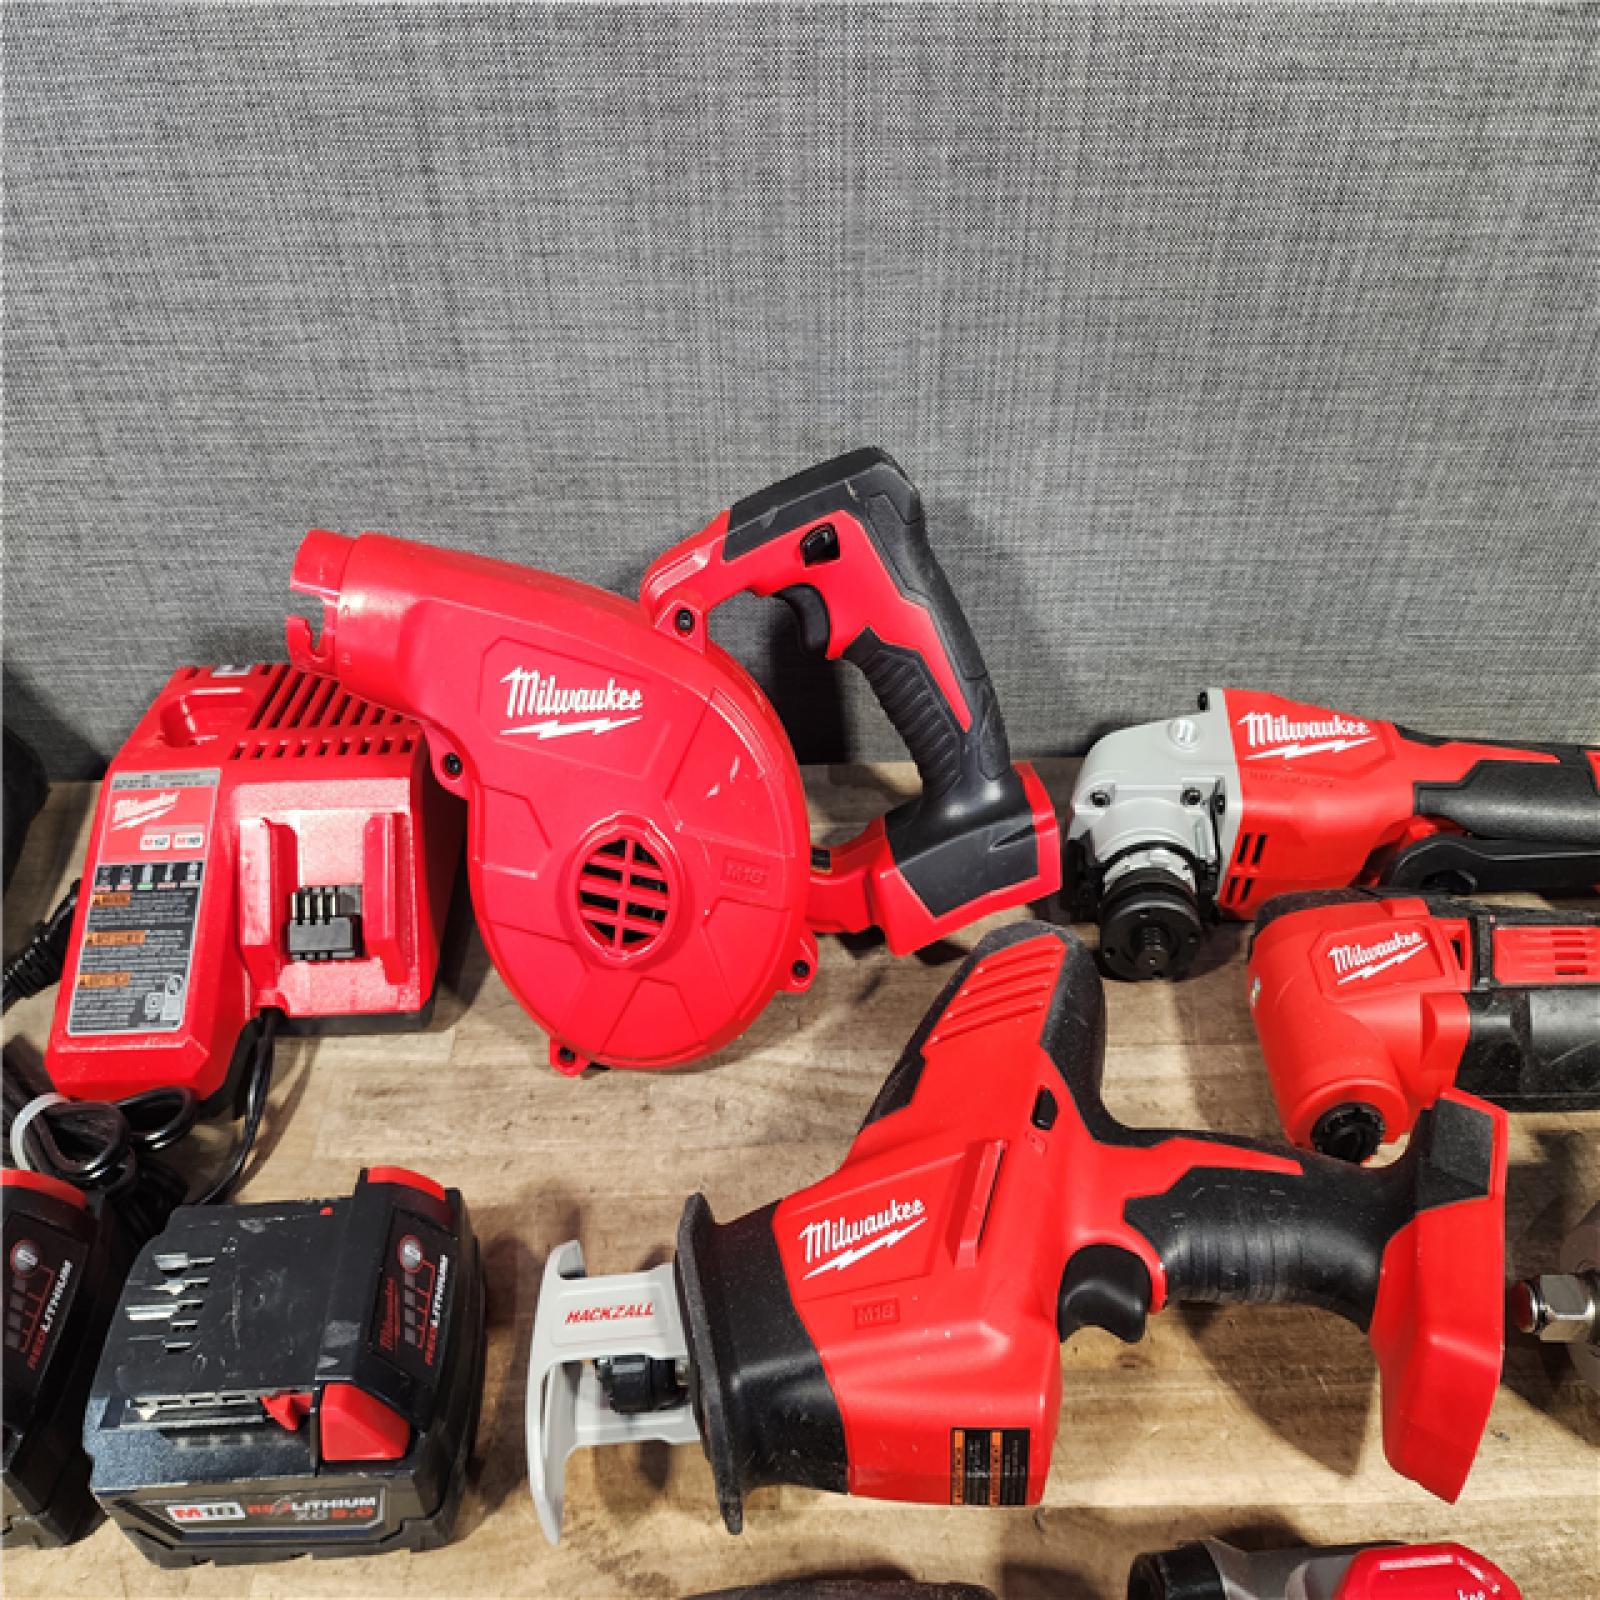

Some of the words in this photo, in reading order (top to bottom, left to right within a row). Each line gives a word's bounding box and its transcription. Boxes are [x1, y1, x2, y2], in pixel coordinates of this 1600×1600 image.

[500, 665, 643, 718] Milwaukee
[1237, 712, 1370, 747] Milwaukee
[1328, 931, 1422, 974] Milwaukee
[798, 1199, 926, 1263] Milwaukee
[564, 1302, 654, 1325] HACKZALL
